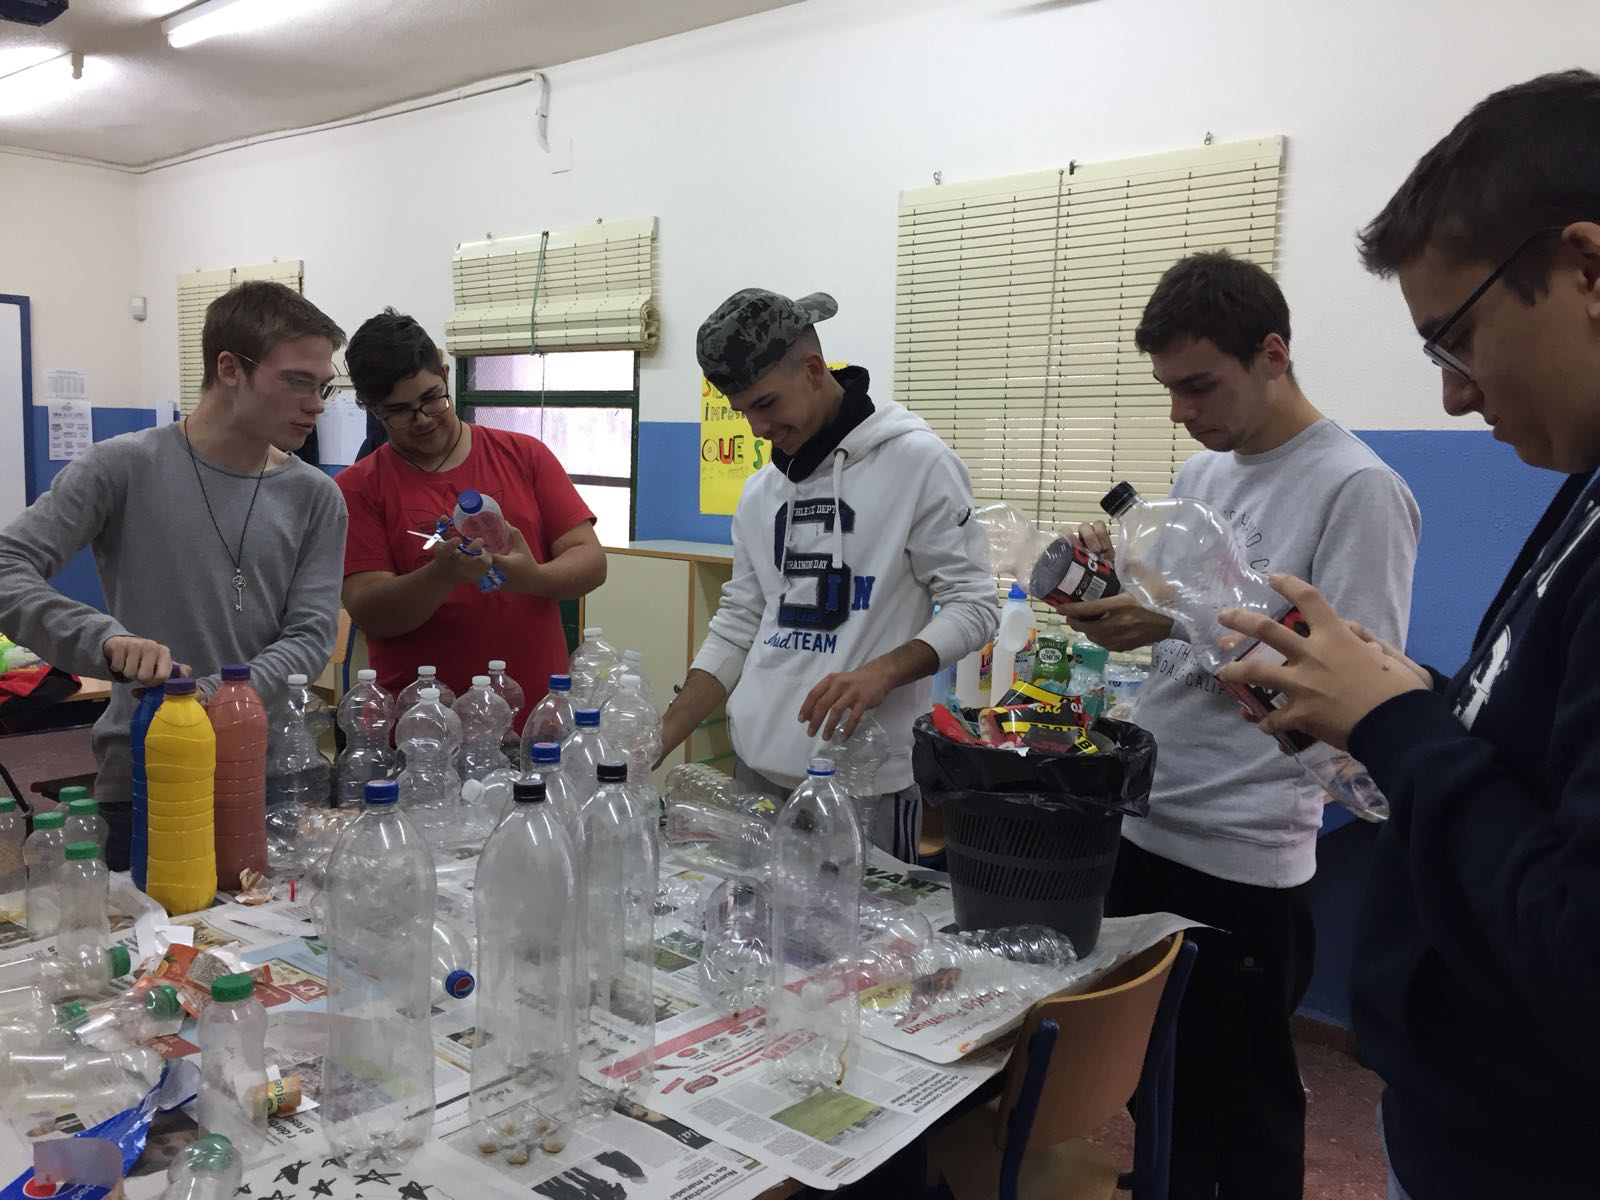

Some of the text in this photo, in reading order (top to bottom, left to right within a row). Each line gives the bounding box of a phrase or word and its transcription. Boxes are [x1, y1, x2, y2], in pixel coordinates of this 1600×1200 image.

[702, 435, 744, 464] QUE
[813, 559, 829, 570] DAY
[792, 631, 837, 654] TEAM
